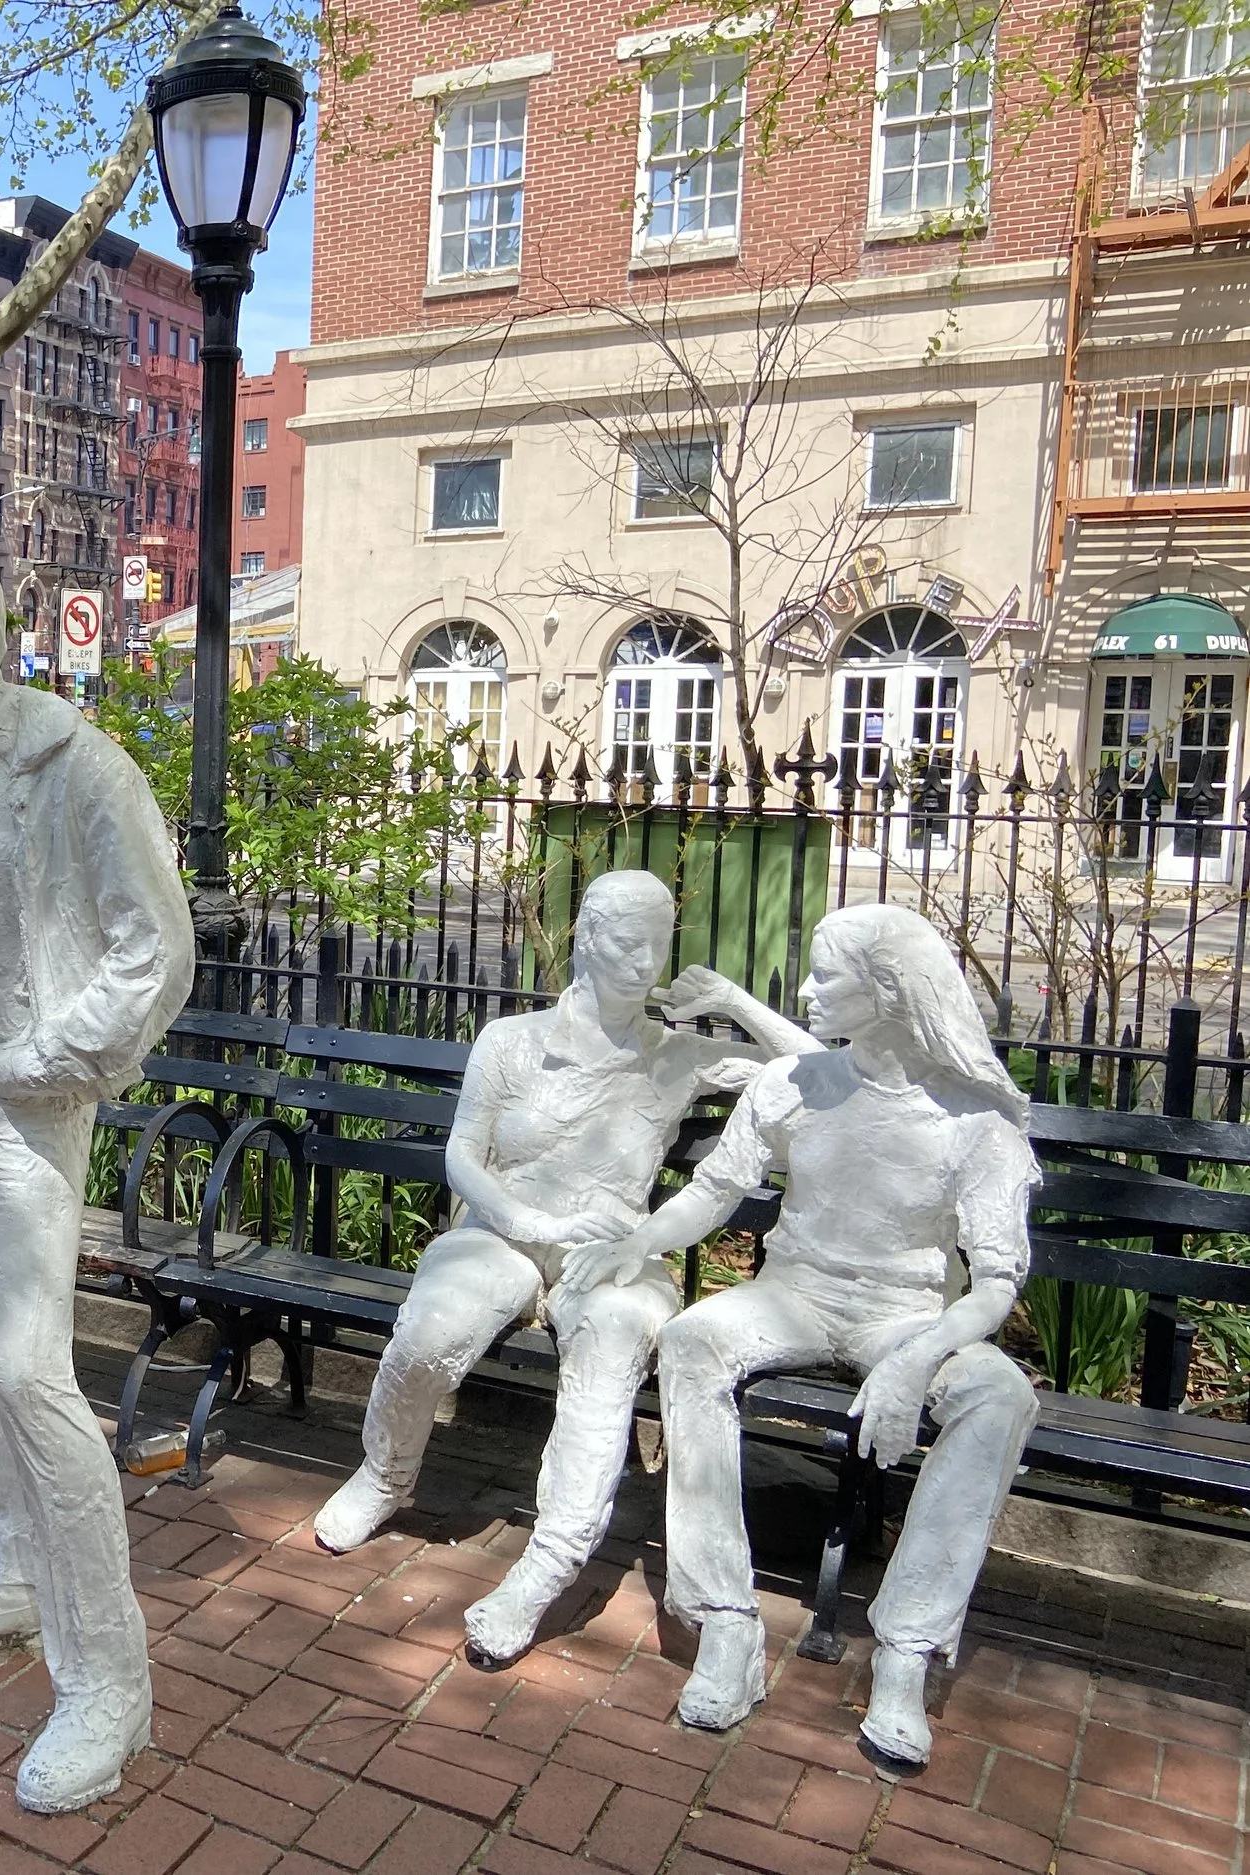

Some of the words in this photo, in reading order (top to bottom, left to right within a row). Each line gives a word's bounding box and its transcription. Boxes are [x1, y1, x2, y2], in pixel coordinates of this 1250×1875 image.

[765, 543, 1041, 662] DUPLEX
[23, 644, 34, 653] 20
[1154, 634, 1179, 650] 61
[69, 661, 91, 671] BIKES
